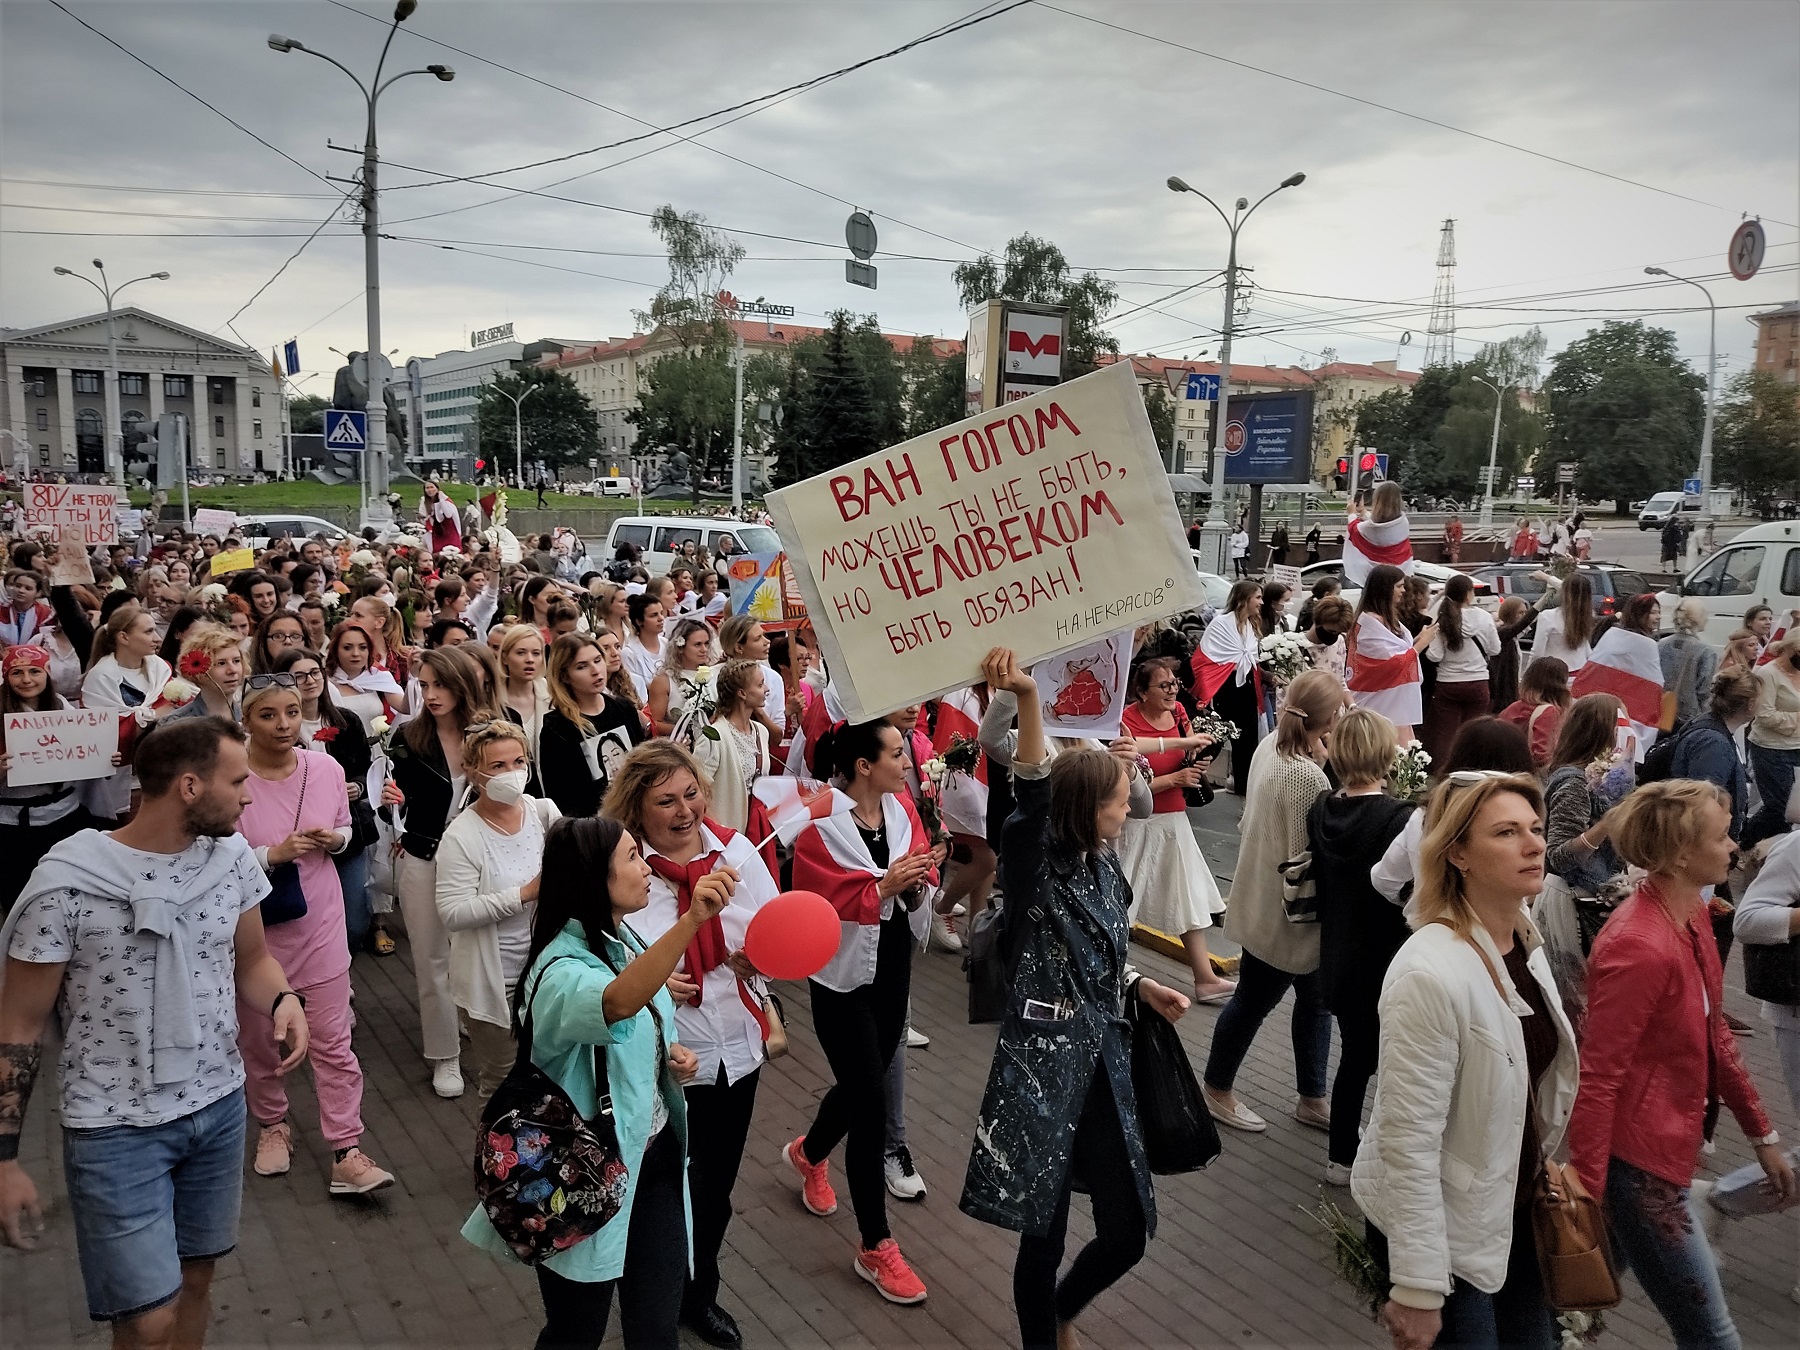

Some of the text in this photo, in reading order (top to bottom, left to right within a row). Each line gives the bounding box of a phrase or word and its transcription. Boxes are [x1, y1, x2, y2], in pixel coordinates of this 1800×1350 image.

[742, 301, 794, 316] HUAWEI
[829, 402, 1081, 522] ВАН ГОГОМ
[32, 485, 70, 508] 80%
[72, 494, 86, 506] НЕ
[26, 508, 59, 523] ВОТ
[65, 508, 90, 522] ТЫ
[99, 508, 111, 522] И
[822, 450, 1126, 582] МОЖЕШЬ ТЫ НЕ БЫТЬ,
[833, 490, 1124, 622] НО ЧЕЛОВЕКОМ
[885, 545, 1084, 654] БЫТЬ ОБЯЗАН!
[10, 712, 110, 730] АЛЬПИНИЗМ
[19, 744, 100, 764] ГЕРОИЗМ
